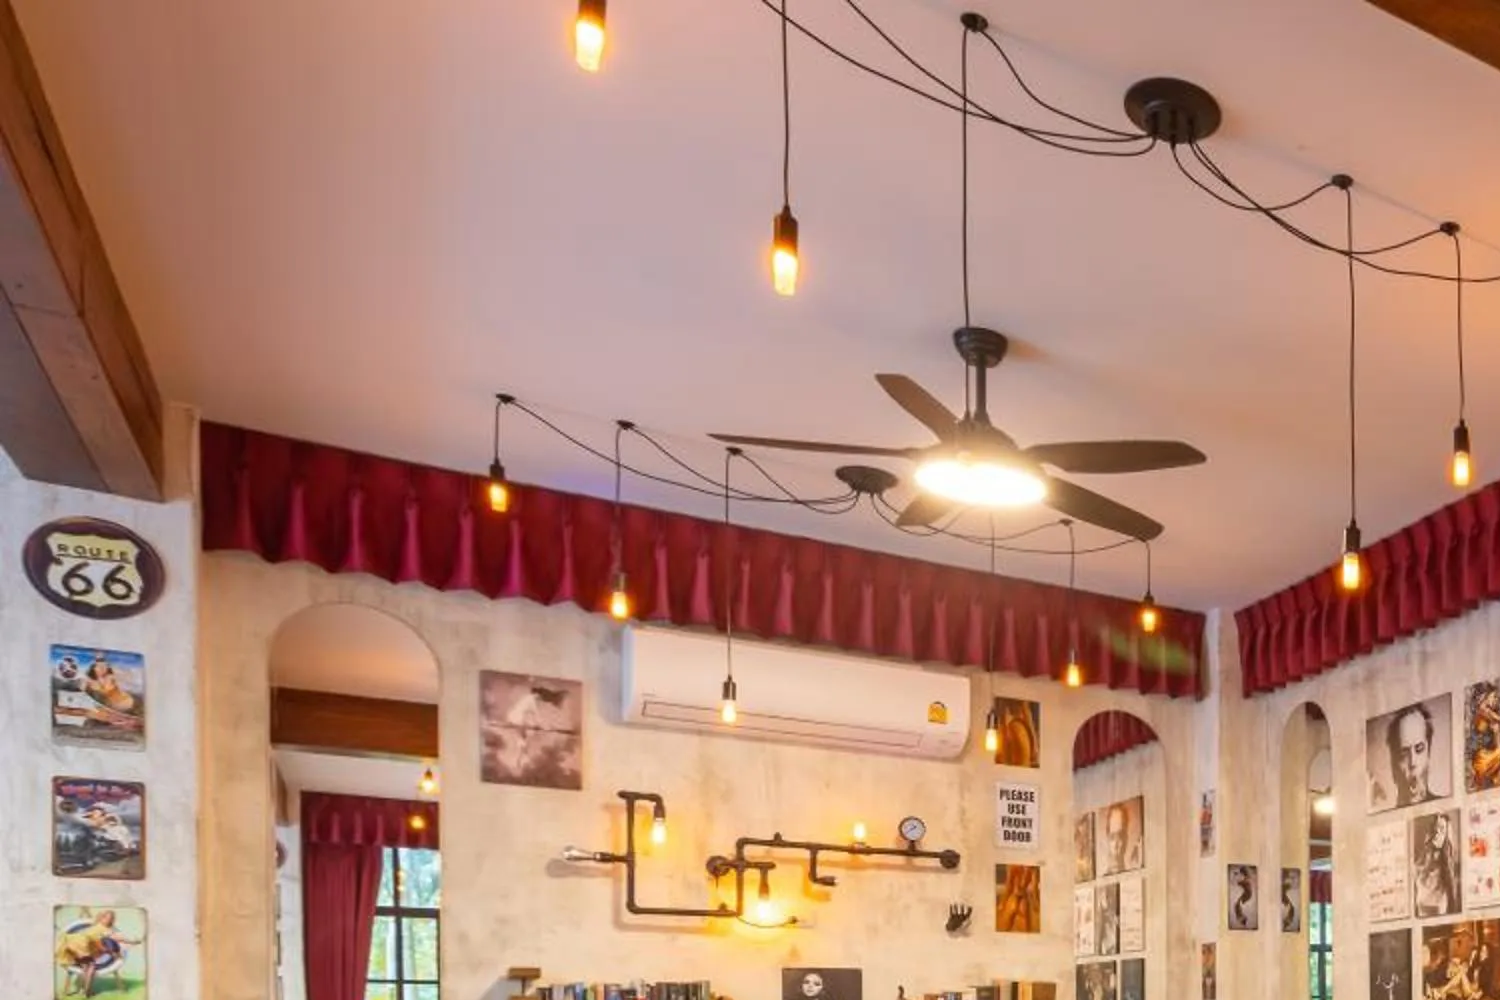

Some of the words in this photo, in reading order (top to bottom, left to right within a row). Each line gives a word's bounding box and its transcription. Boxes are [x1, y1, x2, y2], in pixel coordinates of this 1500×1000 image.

[56, 543, 130, 563] ROUTE
[61, 562, 135, 600] 66
[1000, 789, 1035, 802] PLEASE
[1007, 803, 1026, 815] USE
[1001, 816, 1033, 829] FRONT
[1003, 830, 1031, 842] DOOR
